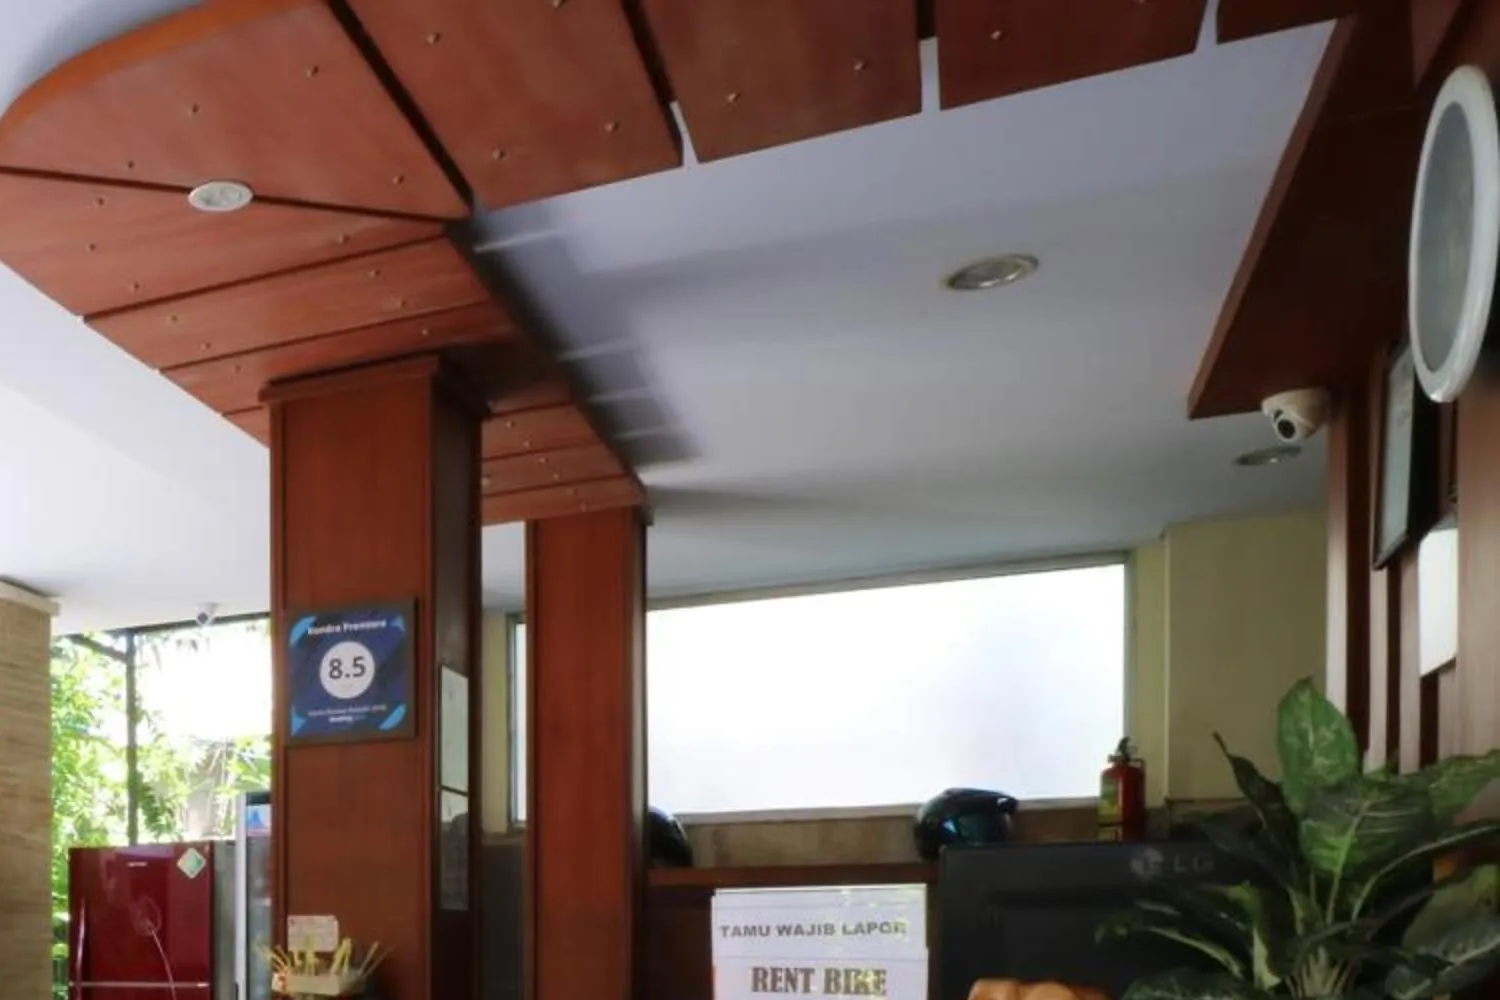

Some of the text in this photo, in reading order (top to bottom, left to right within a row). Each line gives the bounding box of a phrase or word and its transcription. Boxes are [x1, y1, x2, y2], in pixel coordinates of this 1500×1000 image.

[328, 655, 367, 680] 8.5
[1173, 851, 1215, 874] LG
[720, 921, 907, 938] TAMU WAJIB LAPOR
[751, 966, 888, 996] RENT BIKE
